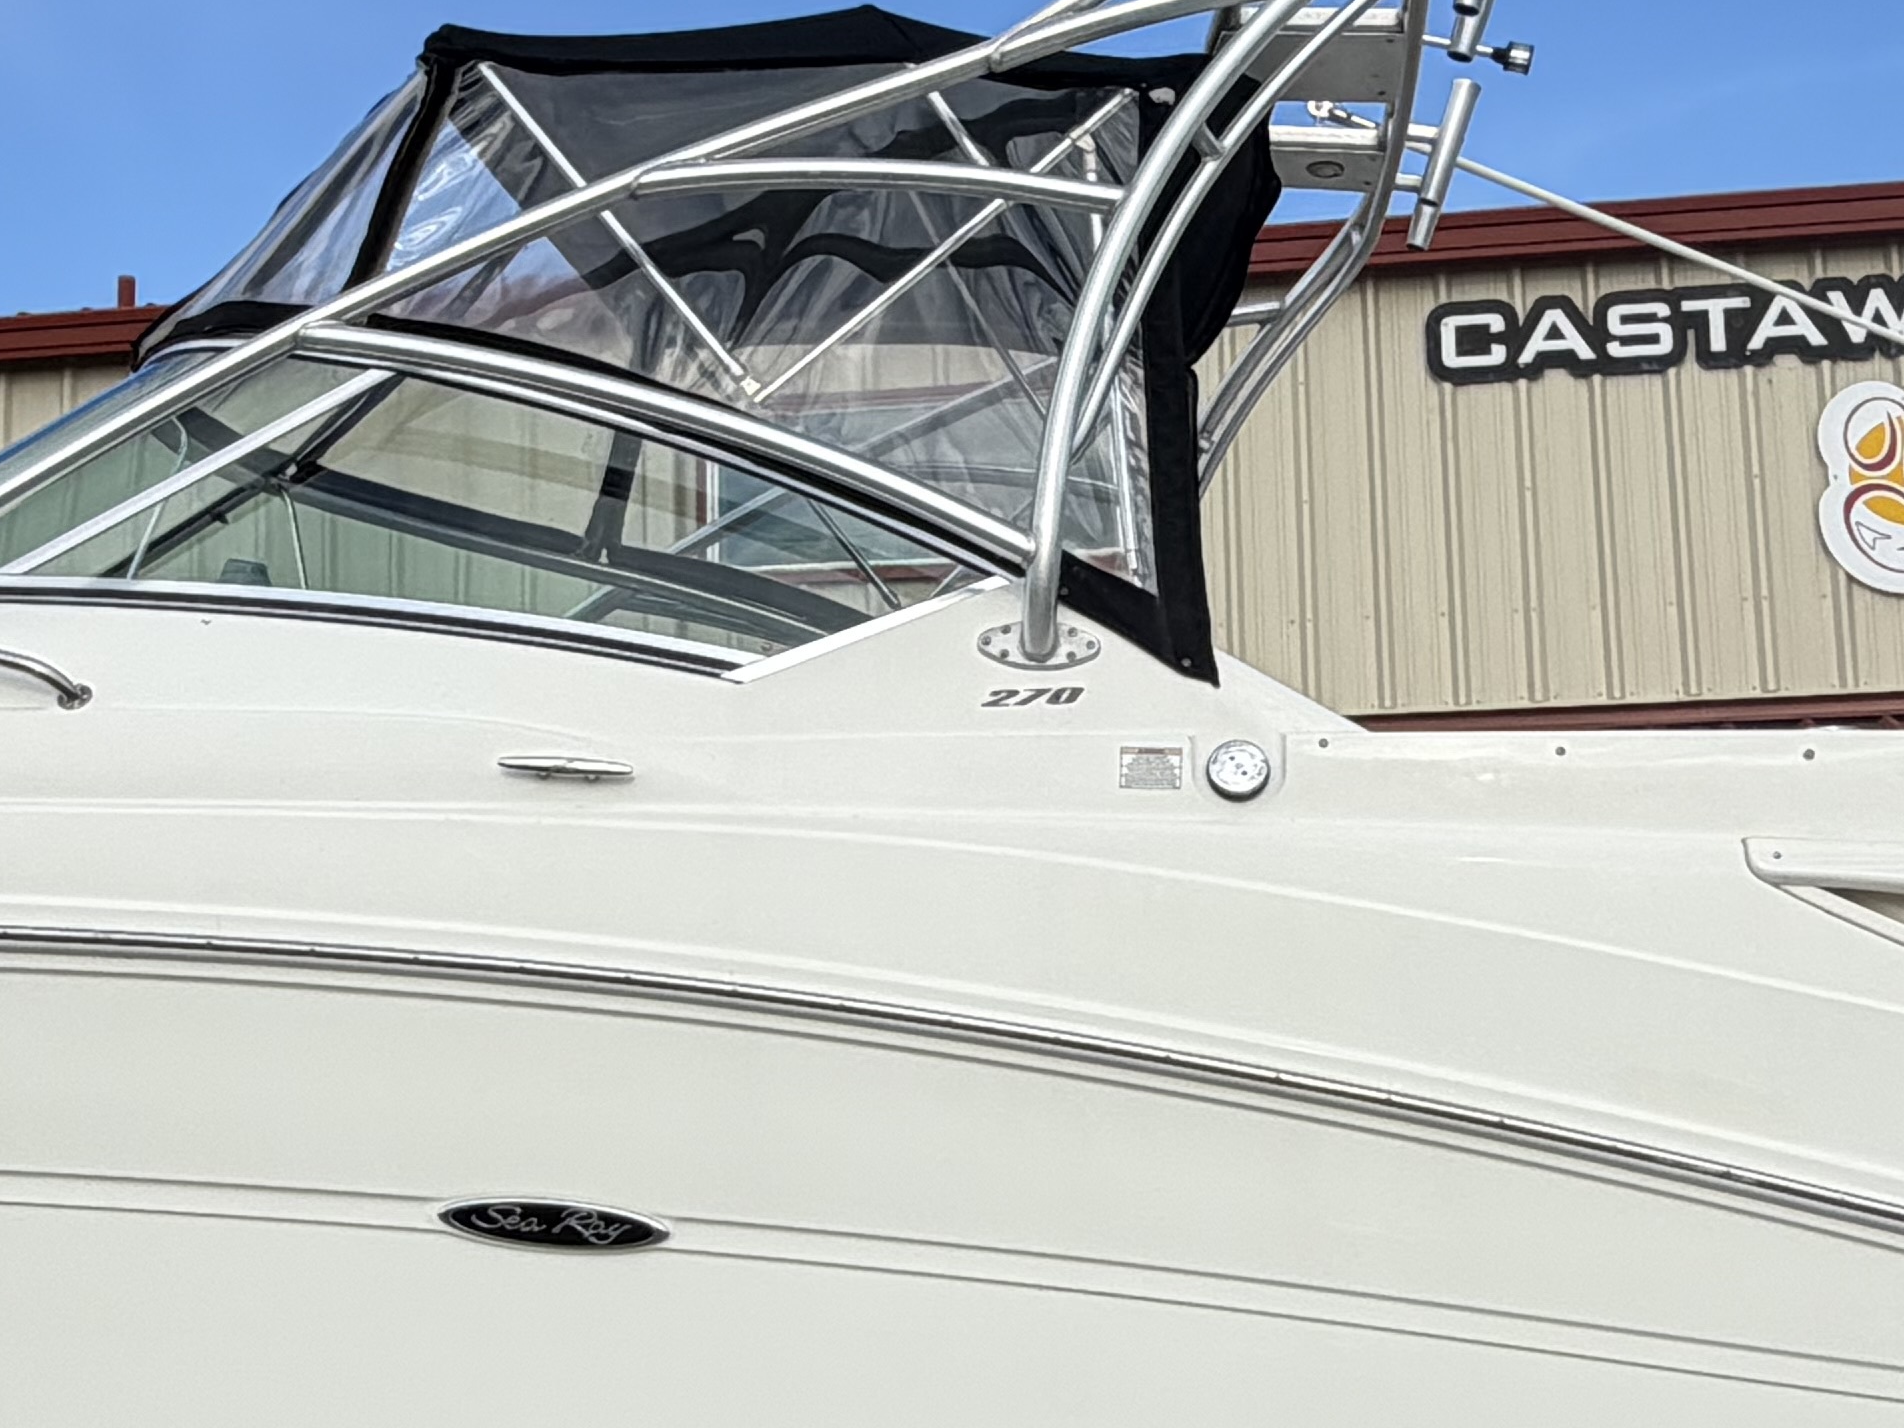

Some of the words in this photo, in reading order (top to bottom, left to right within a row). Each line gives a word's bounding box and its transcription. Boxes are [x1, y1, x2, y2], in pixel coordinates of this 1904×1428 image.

[980, 686, 1085, 707] 270
[470, 1204, 547, 1232] Sea
[551, 1207, 633, 1244] Ray
